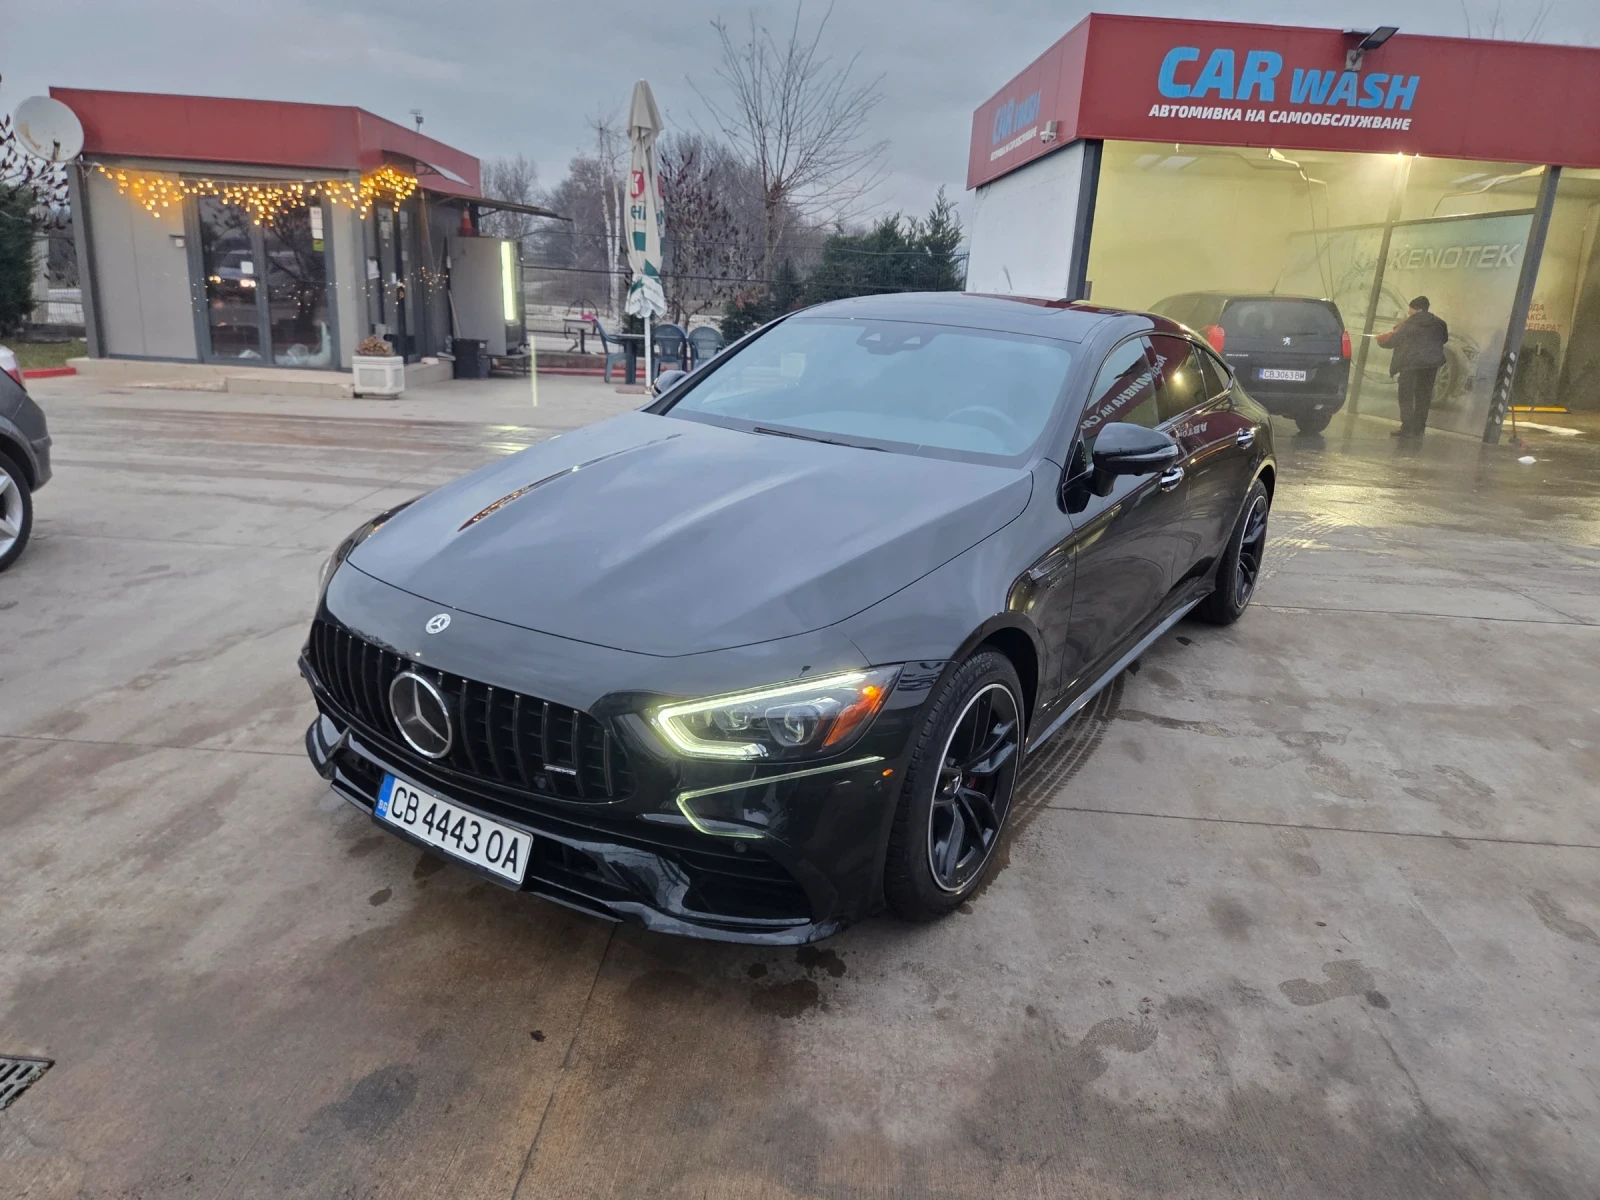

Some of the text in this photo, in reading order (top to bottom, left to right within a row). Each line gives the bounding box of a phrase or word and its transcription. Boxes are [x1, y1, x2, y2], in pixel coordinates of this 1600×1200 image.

[1157, 46, 1421, 111] CAR WASH
[1148, 104, 1412, 131] АВТОМИВКА НА САМООБСЛУЖВАНЕ
[1389, 243, 1521, 270] KENOTEK
[1264, 370, 1275, 378] CB
[1275, 371, 1294, 379] 3063
[377, 800, 388, 812] BG
[391, 786, 518, 874] CB 4443 OA
